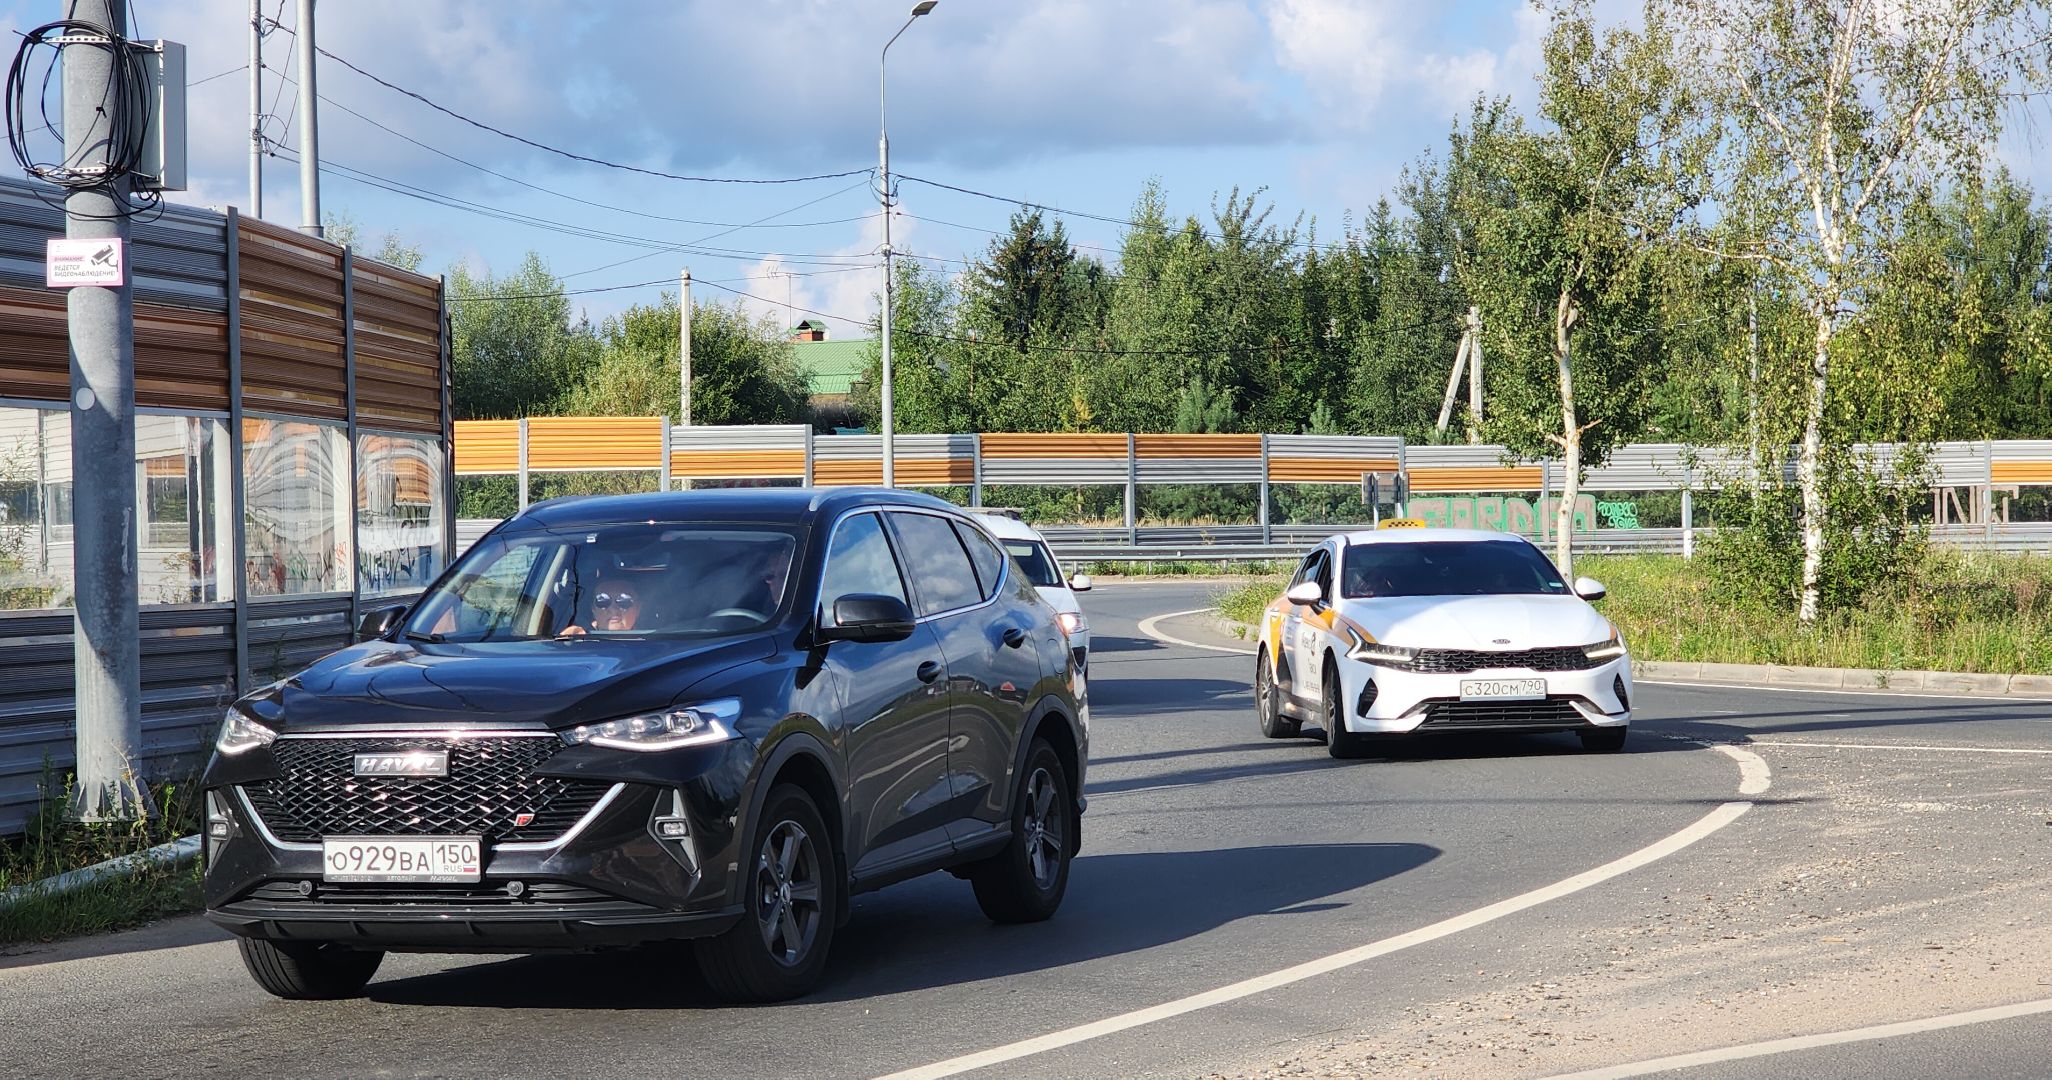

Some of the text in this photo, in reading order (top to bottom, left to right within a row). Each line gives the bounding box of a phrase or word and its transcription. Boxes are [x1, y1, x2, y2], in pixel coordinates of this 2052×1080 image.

[1520, 680, 1541, 692] 790
[360, 757, 441, 772] HAVAL
[436, 844, 473, 864] 150
[443, 864, 463, 873] RUS
